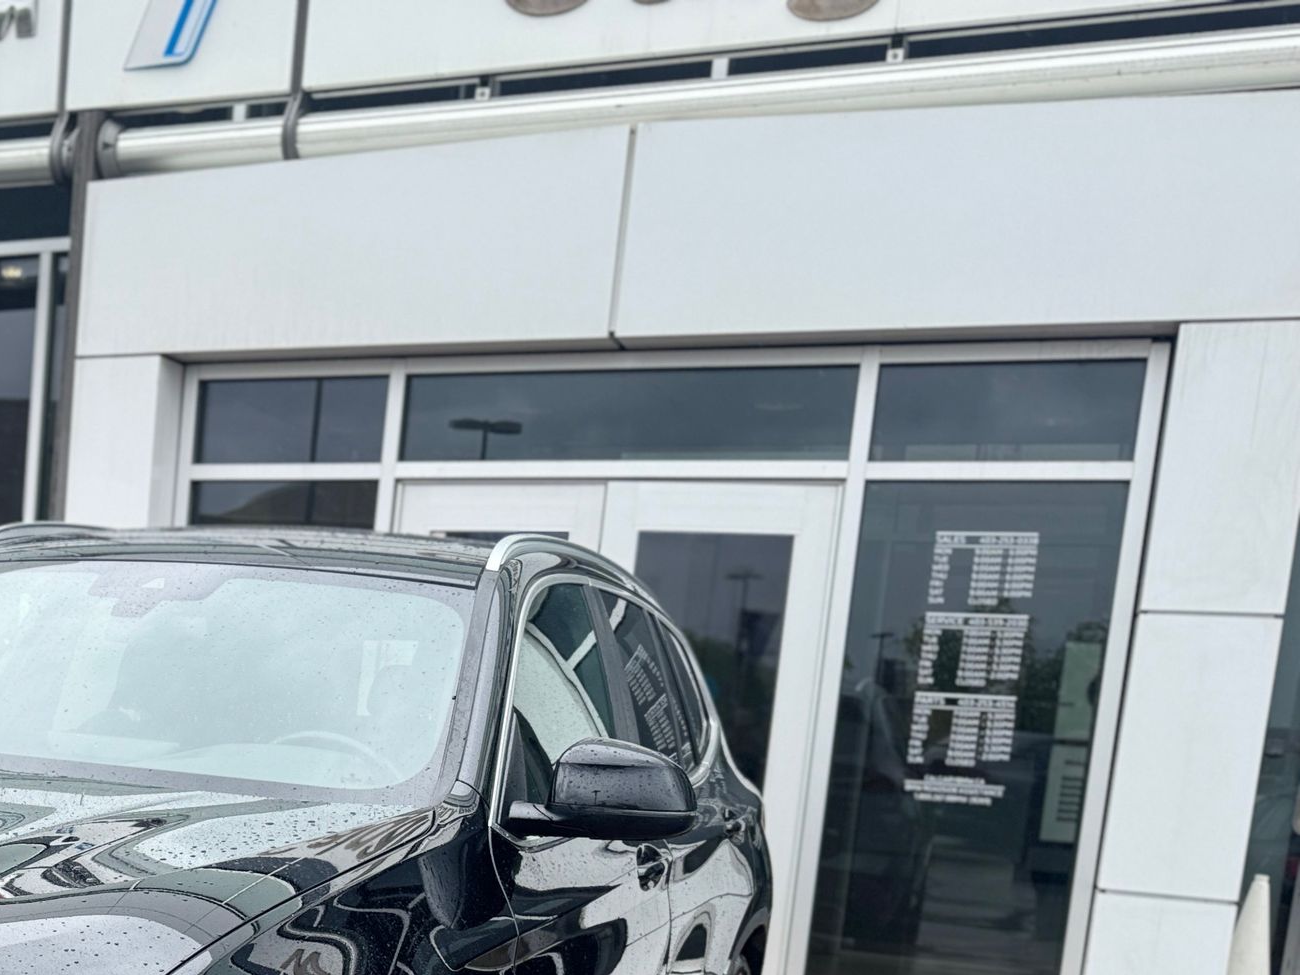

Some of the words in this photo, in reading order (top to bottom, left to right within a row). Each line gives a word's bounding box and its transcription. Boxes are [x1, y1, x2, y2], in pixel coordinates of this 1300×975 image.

[934, 535, 966, 543] SALES
[925, 615, 963, 625] SERVICE
[914, 695, 945, 705] PARTS
